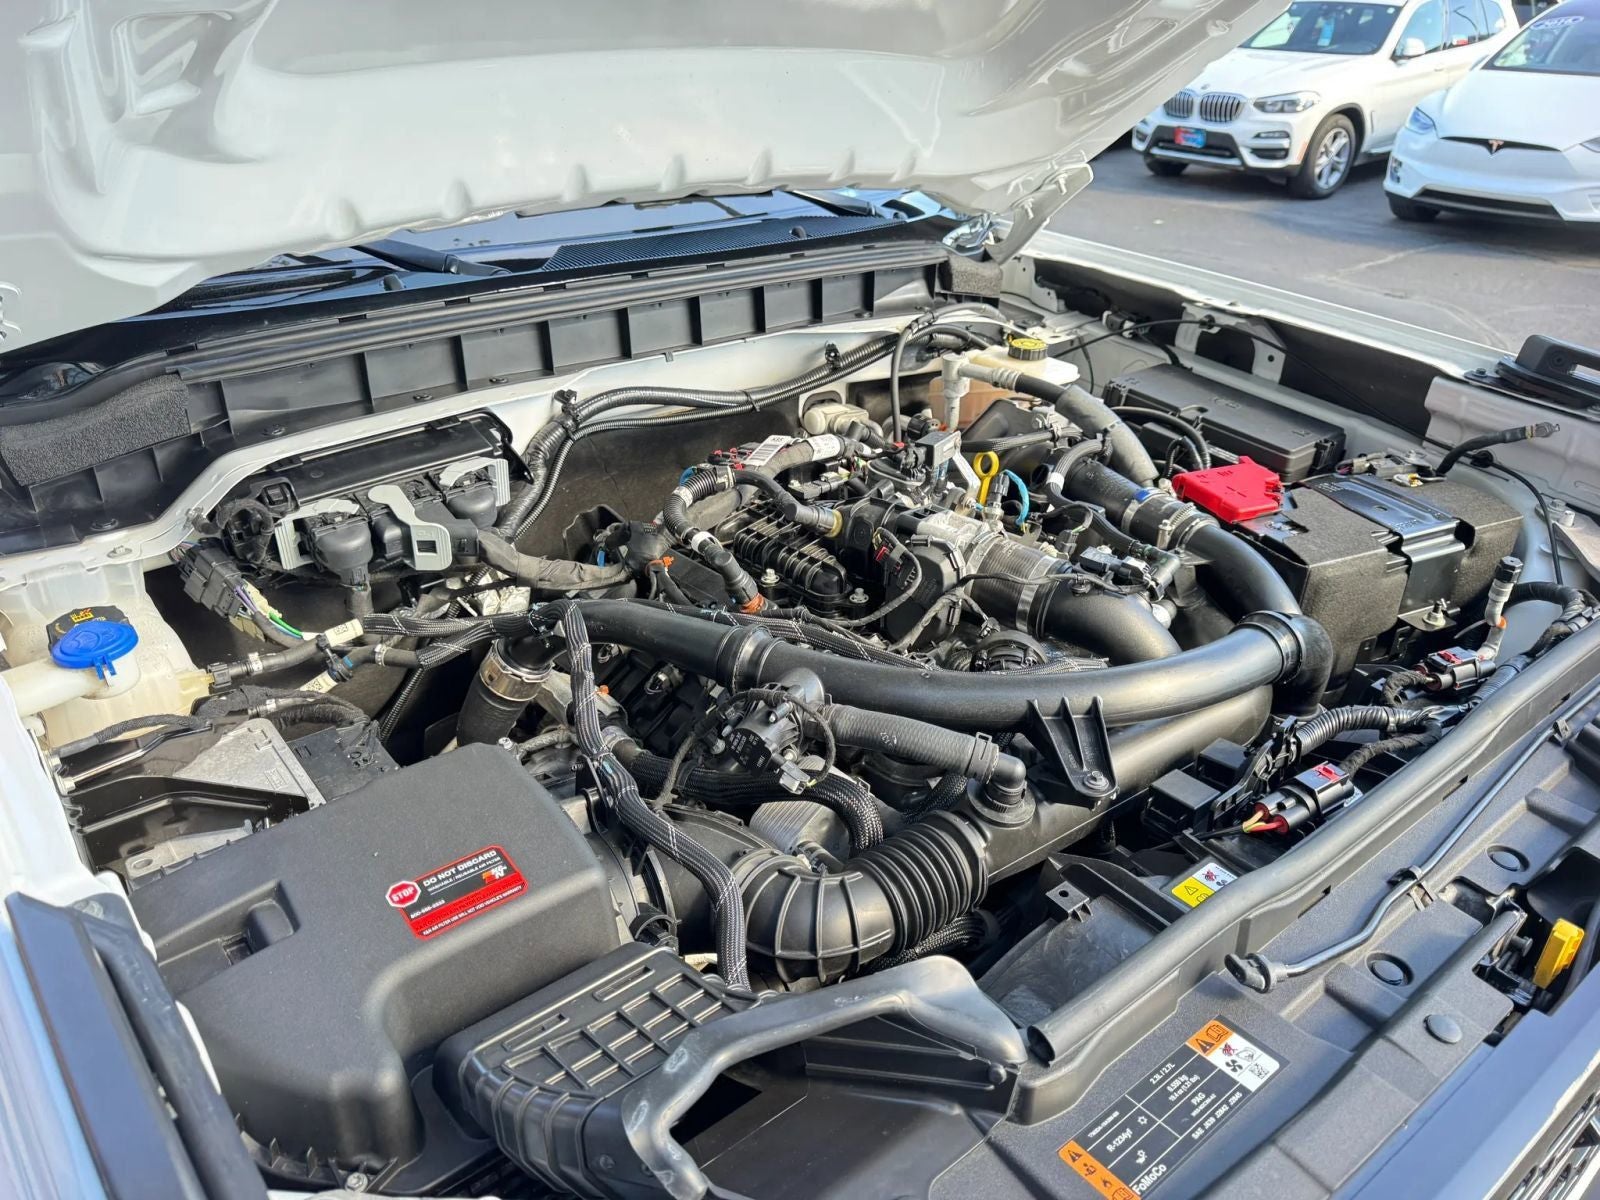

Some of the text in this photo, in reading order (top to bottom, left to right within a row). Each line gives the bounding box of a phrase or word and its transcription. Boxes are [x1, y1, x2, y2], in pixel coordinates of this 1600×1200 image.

[423, 850, 496, 887] DO NOT DISCARD
[391, 886, 415, 902] STOP
[1191, 1092, 1206, 1106] PAG
[1106, 1128, 1132, 1152] R-1234yf
[1192, 1127, 1204, 1140] SAE
[1132, 1164, 1167, 1195] FoMoCo
